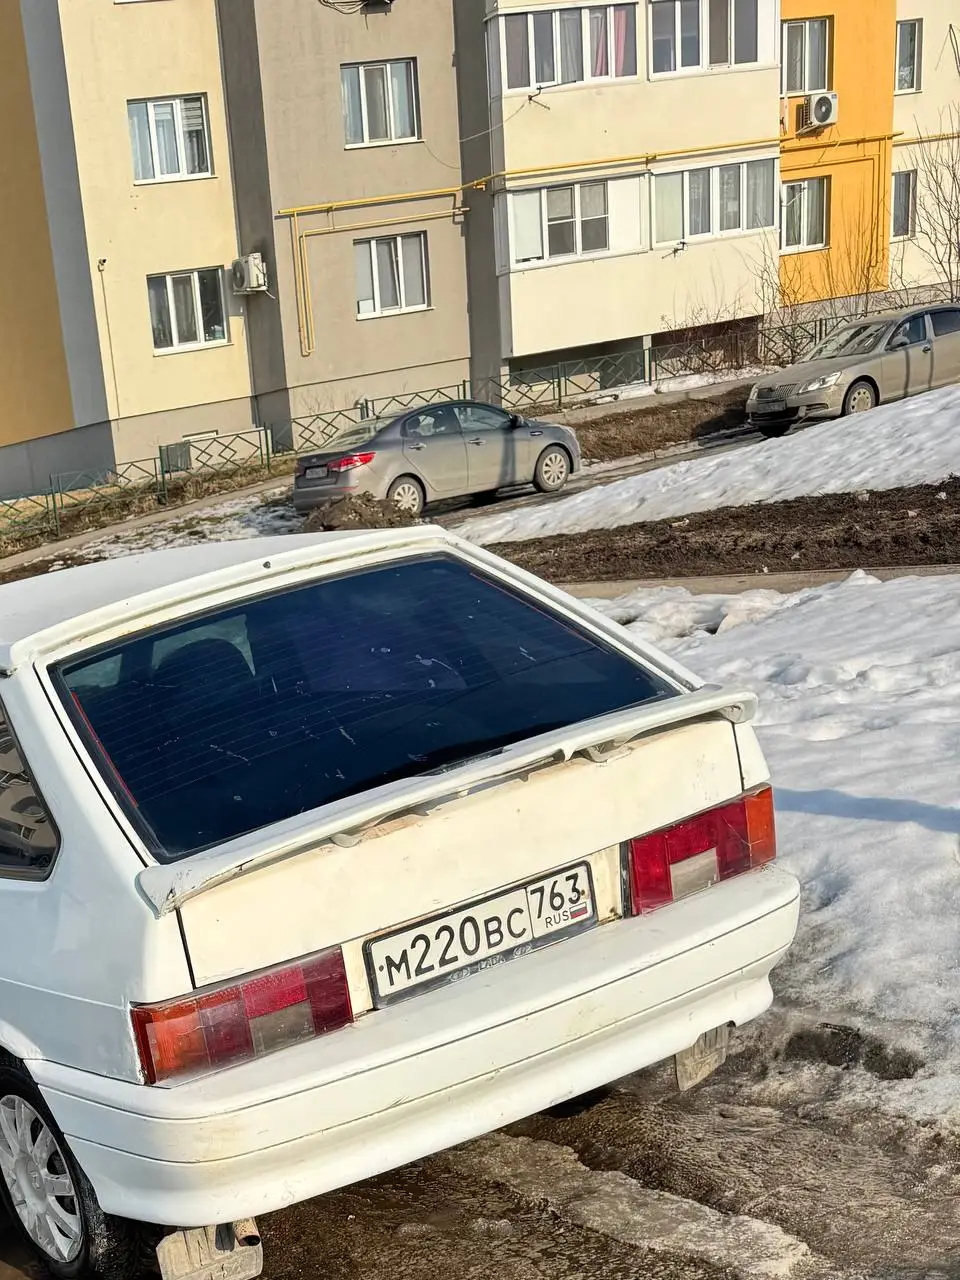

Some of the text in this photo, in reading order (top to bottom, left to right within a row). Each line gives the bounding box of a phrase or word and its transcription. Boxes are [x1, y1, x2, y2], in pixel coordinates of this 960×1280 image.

[530, 872, 581, 919] 763
[544, 910, 570, 929] RUS
[384, 907, 527, 987] М220ВС
